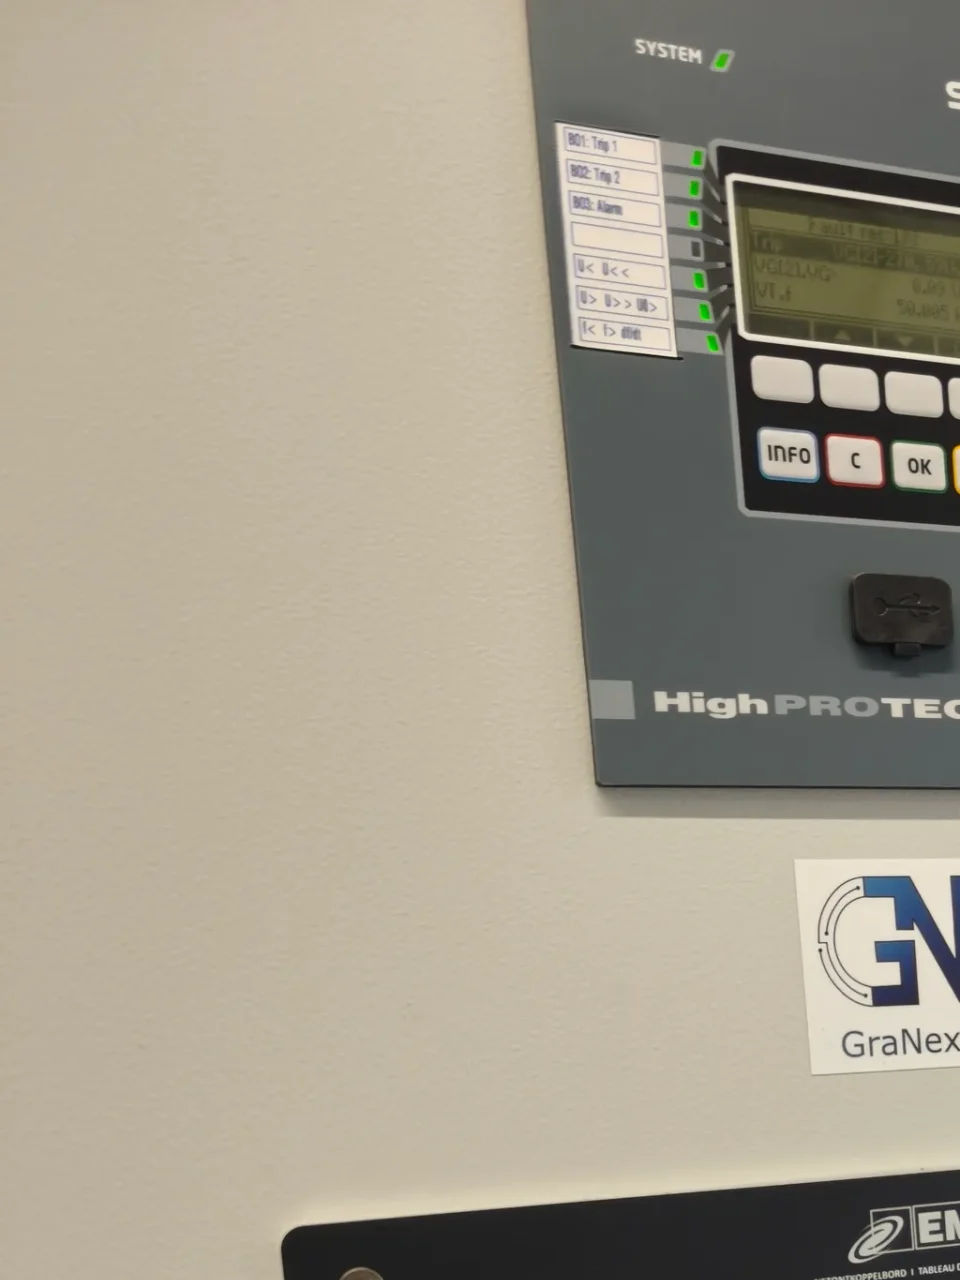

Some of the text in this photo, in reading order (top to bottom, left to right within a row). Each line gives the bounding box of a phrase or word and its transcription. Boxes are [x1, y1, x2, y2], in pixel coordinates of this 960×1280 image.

[635, 38, 702, 64] SYSTEM
[592, 135, 610, 153] Trip
[612, 140, 618, 151] 1
[594, 167, 612, 184] Trip
[614, 171, 621, 184] 2
[597, 199, 623, 216] Alarm
[767, 444, 811, 465] INFO
[850, 452, 862, 469] C
[907, 457, 932, 476] OK
[918, 1264, 955, 1276] TABLEAU
